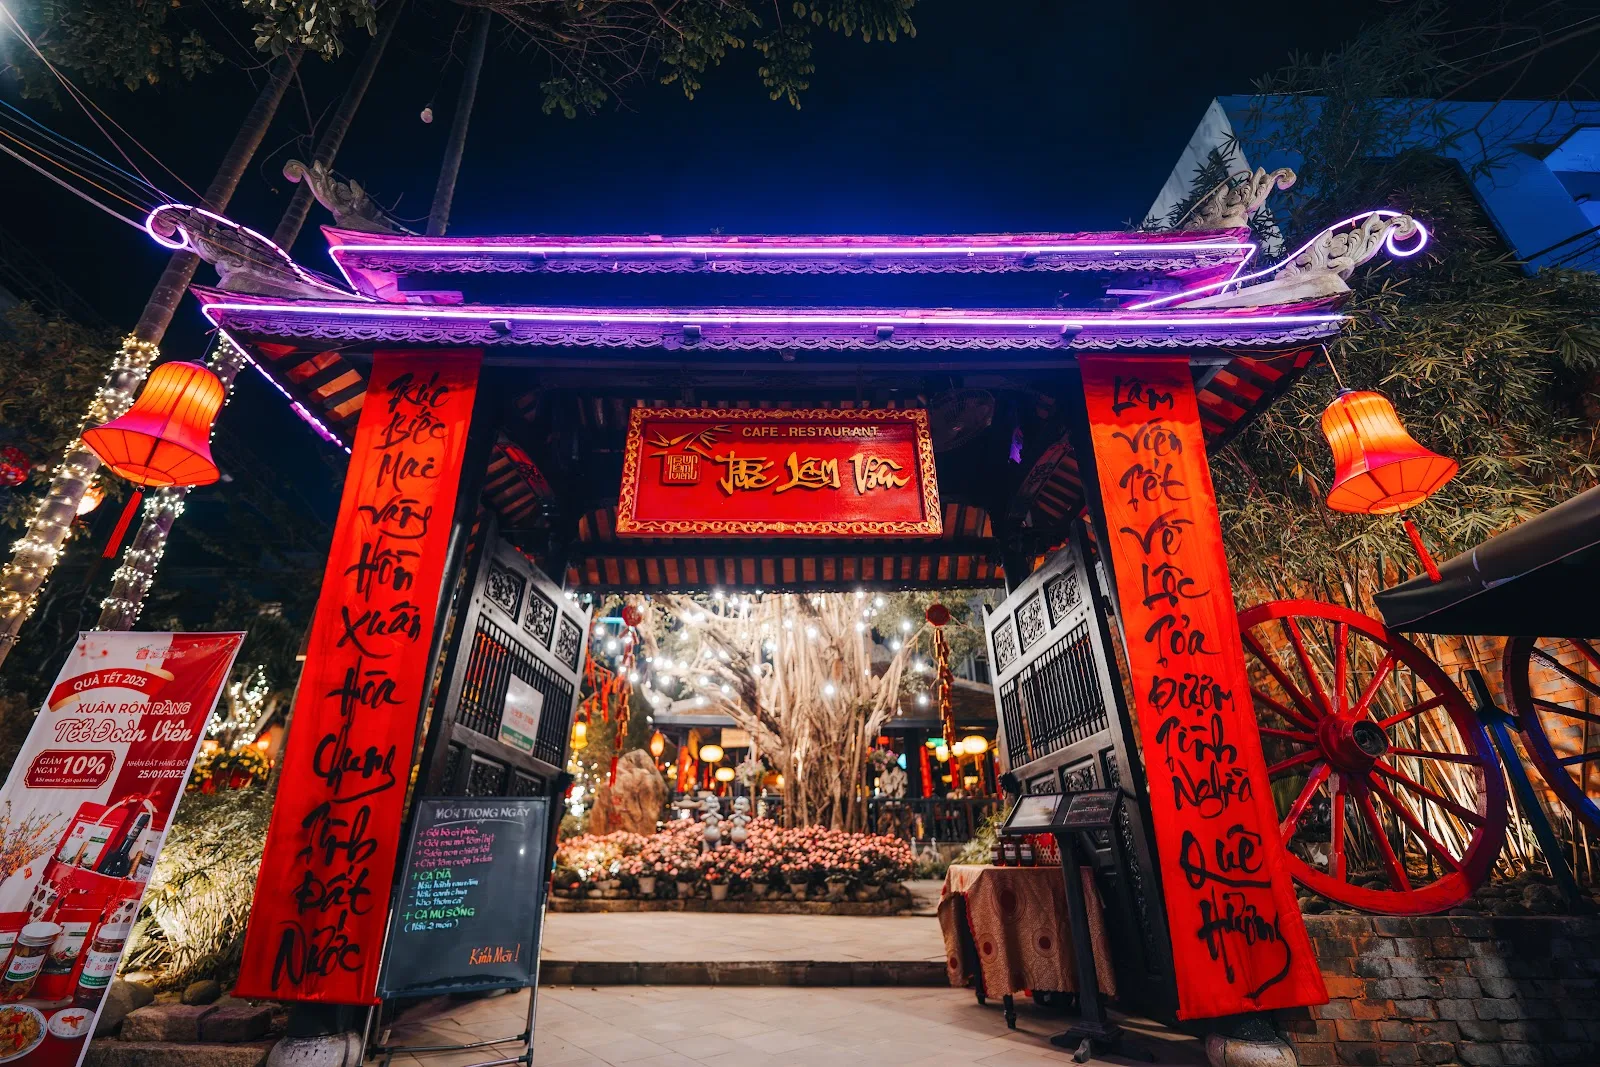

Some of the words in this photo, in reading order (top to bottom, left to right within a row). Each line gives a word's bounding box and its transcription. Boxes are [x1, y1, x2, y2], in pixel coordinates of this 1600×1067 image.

[387, 372, 450, 414] Trúc
[1112, 376, 1174, 416] Lâm
[372, 406, 448, 450] Biếc
[742, 427, 779, 437] CAFE
[789, 426, 879, 437] RESTAURANT
[1112, 418, 1182, 456] Viên
[1119, 458, 1192, 512] Tết
[358, 494, 432, 539] Vàng
[1120, 509, 1194, 556] Về
[344, 536, 420, 602] Hồn
[1142, 562, 1212, 610] Lộc
[337, 601, 421, 658] Xuân
[74, 674, 100, 691] QUÀ
[102, 671, 122, 684] TẾT
[122, 674, 148, 688] 2025
[76, 701, 117, 714] XUÂN
[118, 701, 150, 717] RỘN
[150, 700, 192, 715] RÀNG
[55, 718, 94, 743] Tết
[91, 718, 147, 743] Đoàn
[151, 719, 193, 742] Viên
[1156, 714, 1238, 773] Tình
[34, 766, 59, 774] NGAY
[63, 756, 106, 775] 10%
[137, 769, 187, 779] 25/01/2025
[313, 725, 396, 803] Chung
[435, 805, 460, 819] MÓN
[461, 807, 498, 818] TRONG
[297, 802, 378, 866] Tình
[1179, 825, 1272, 889] Quê
[291, 865, 374, 916] Đất
[414, 906, 431, 920] CÁ
[446, 904, 475, 918] SỐNG
[272, 910, 364, 991] Nước
[468, 946, 492, 965] Kính
